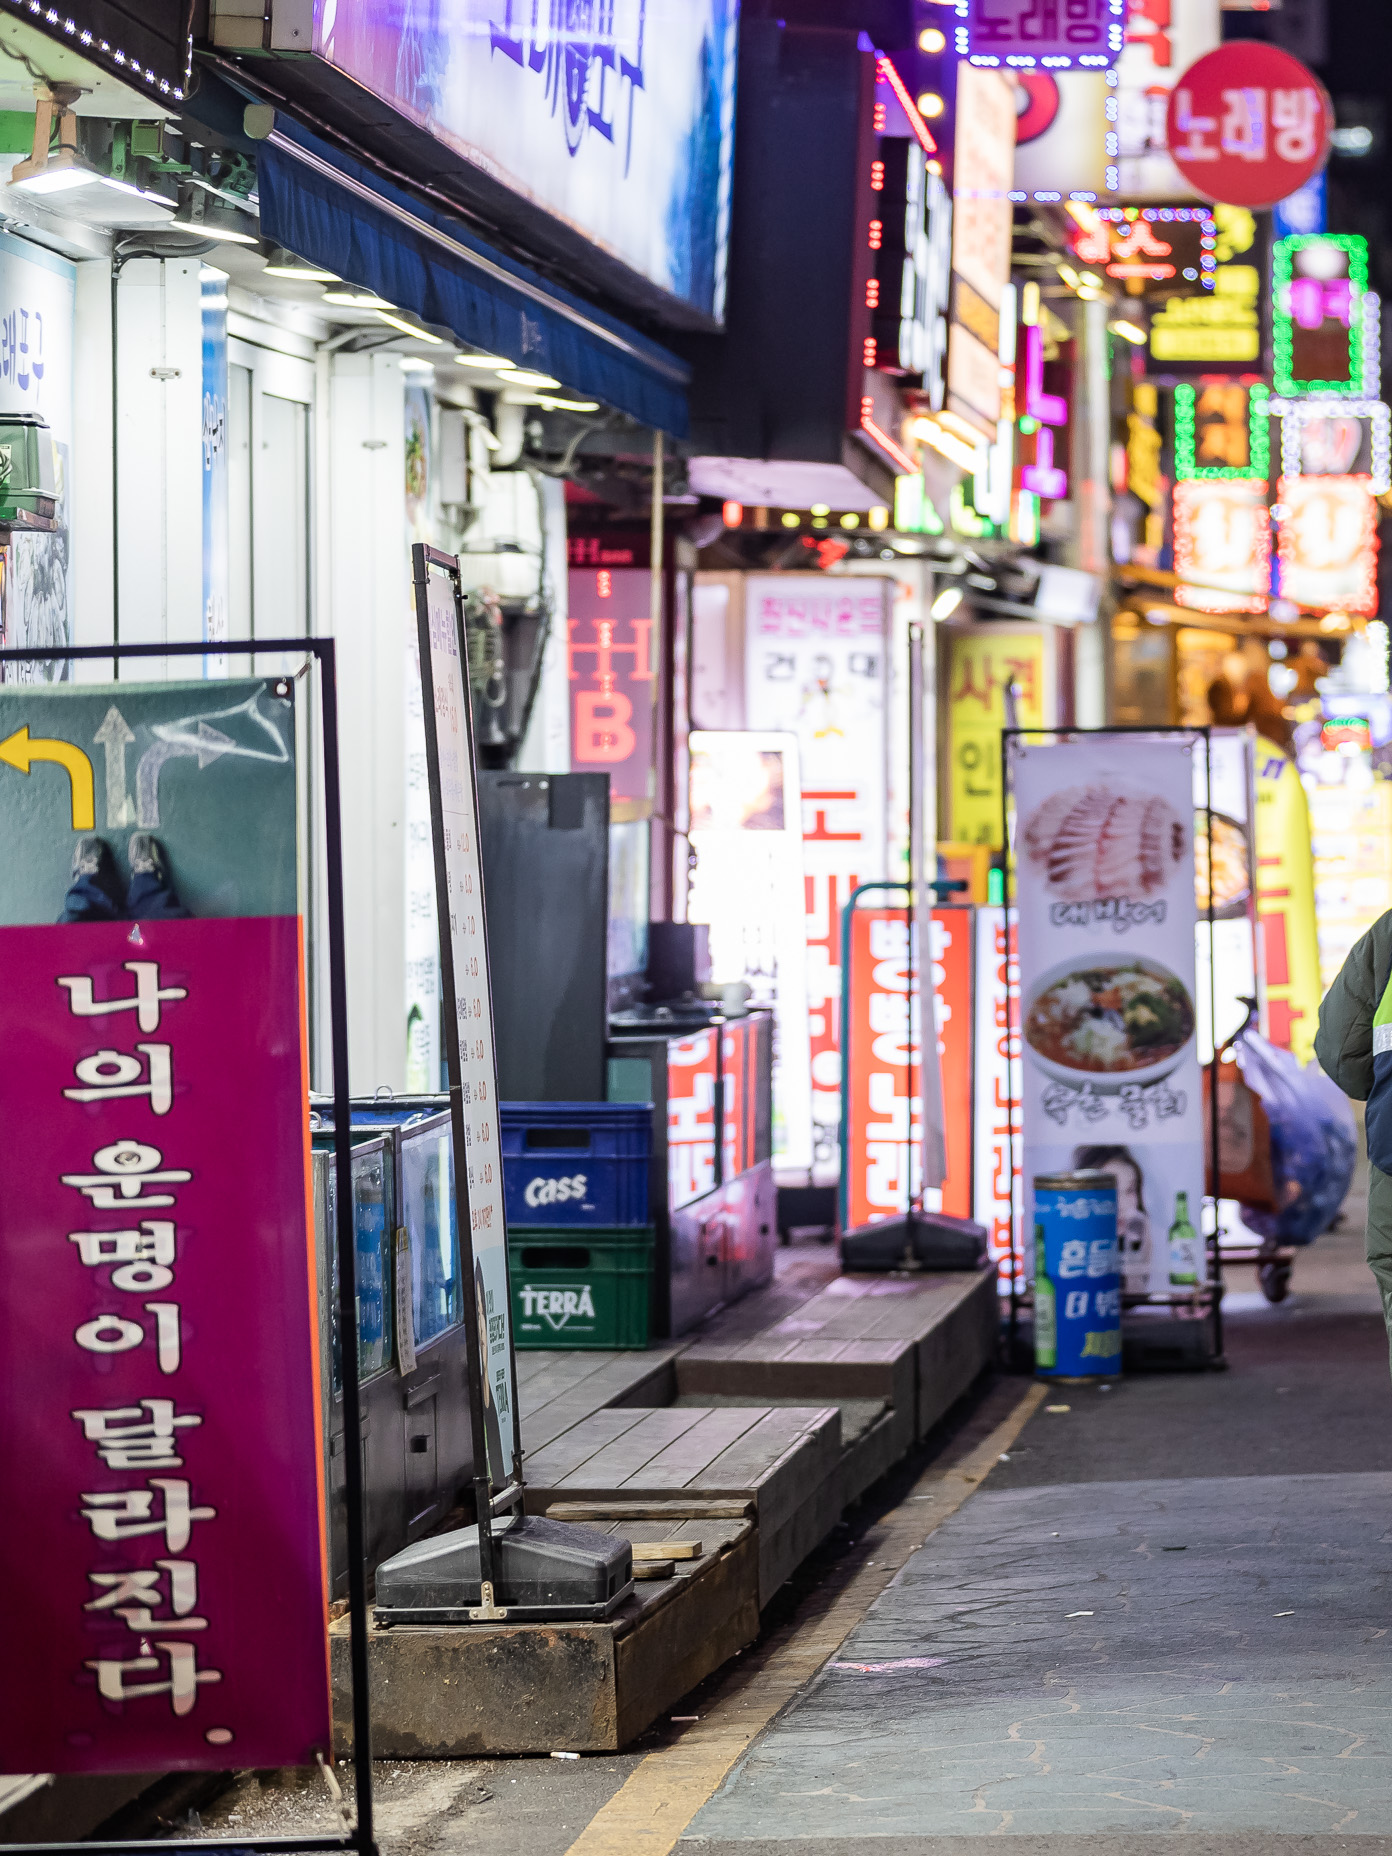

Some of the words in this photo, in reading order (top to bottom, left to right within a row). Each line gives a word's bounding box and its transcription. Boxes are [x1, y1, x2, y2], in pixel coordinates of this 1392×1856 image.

[1174, 87, 1321, 163] 노래방
[0, 307, 45, 405] 래포구
[1049, 896, 1167, 935] 대방어
[55, 960, 189, 1117] 나의
[1119, 1080, 1188, 1130] 물회
[60, 1139, 194, 1376] 운명이
[519, 1285, 596, 1318] TERRA
[71, 1398, 235, 1745] 달라진다.
